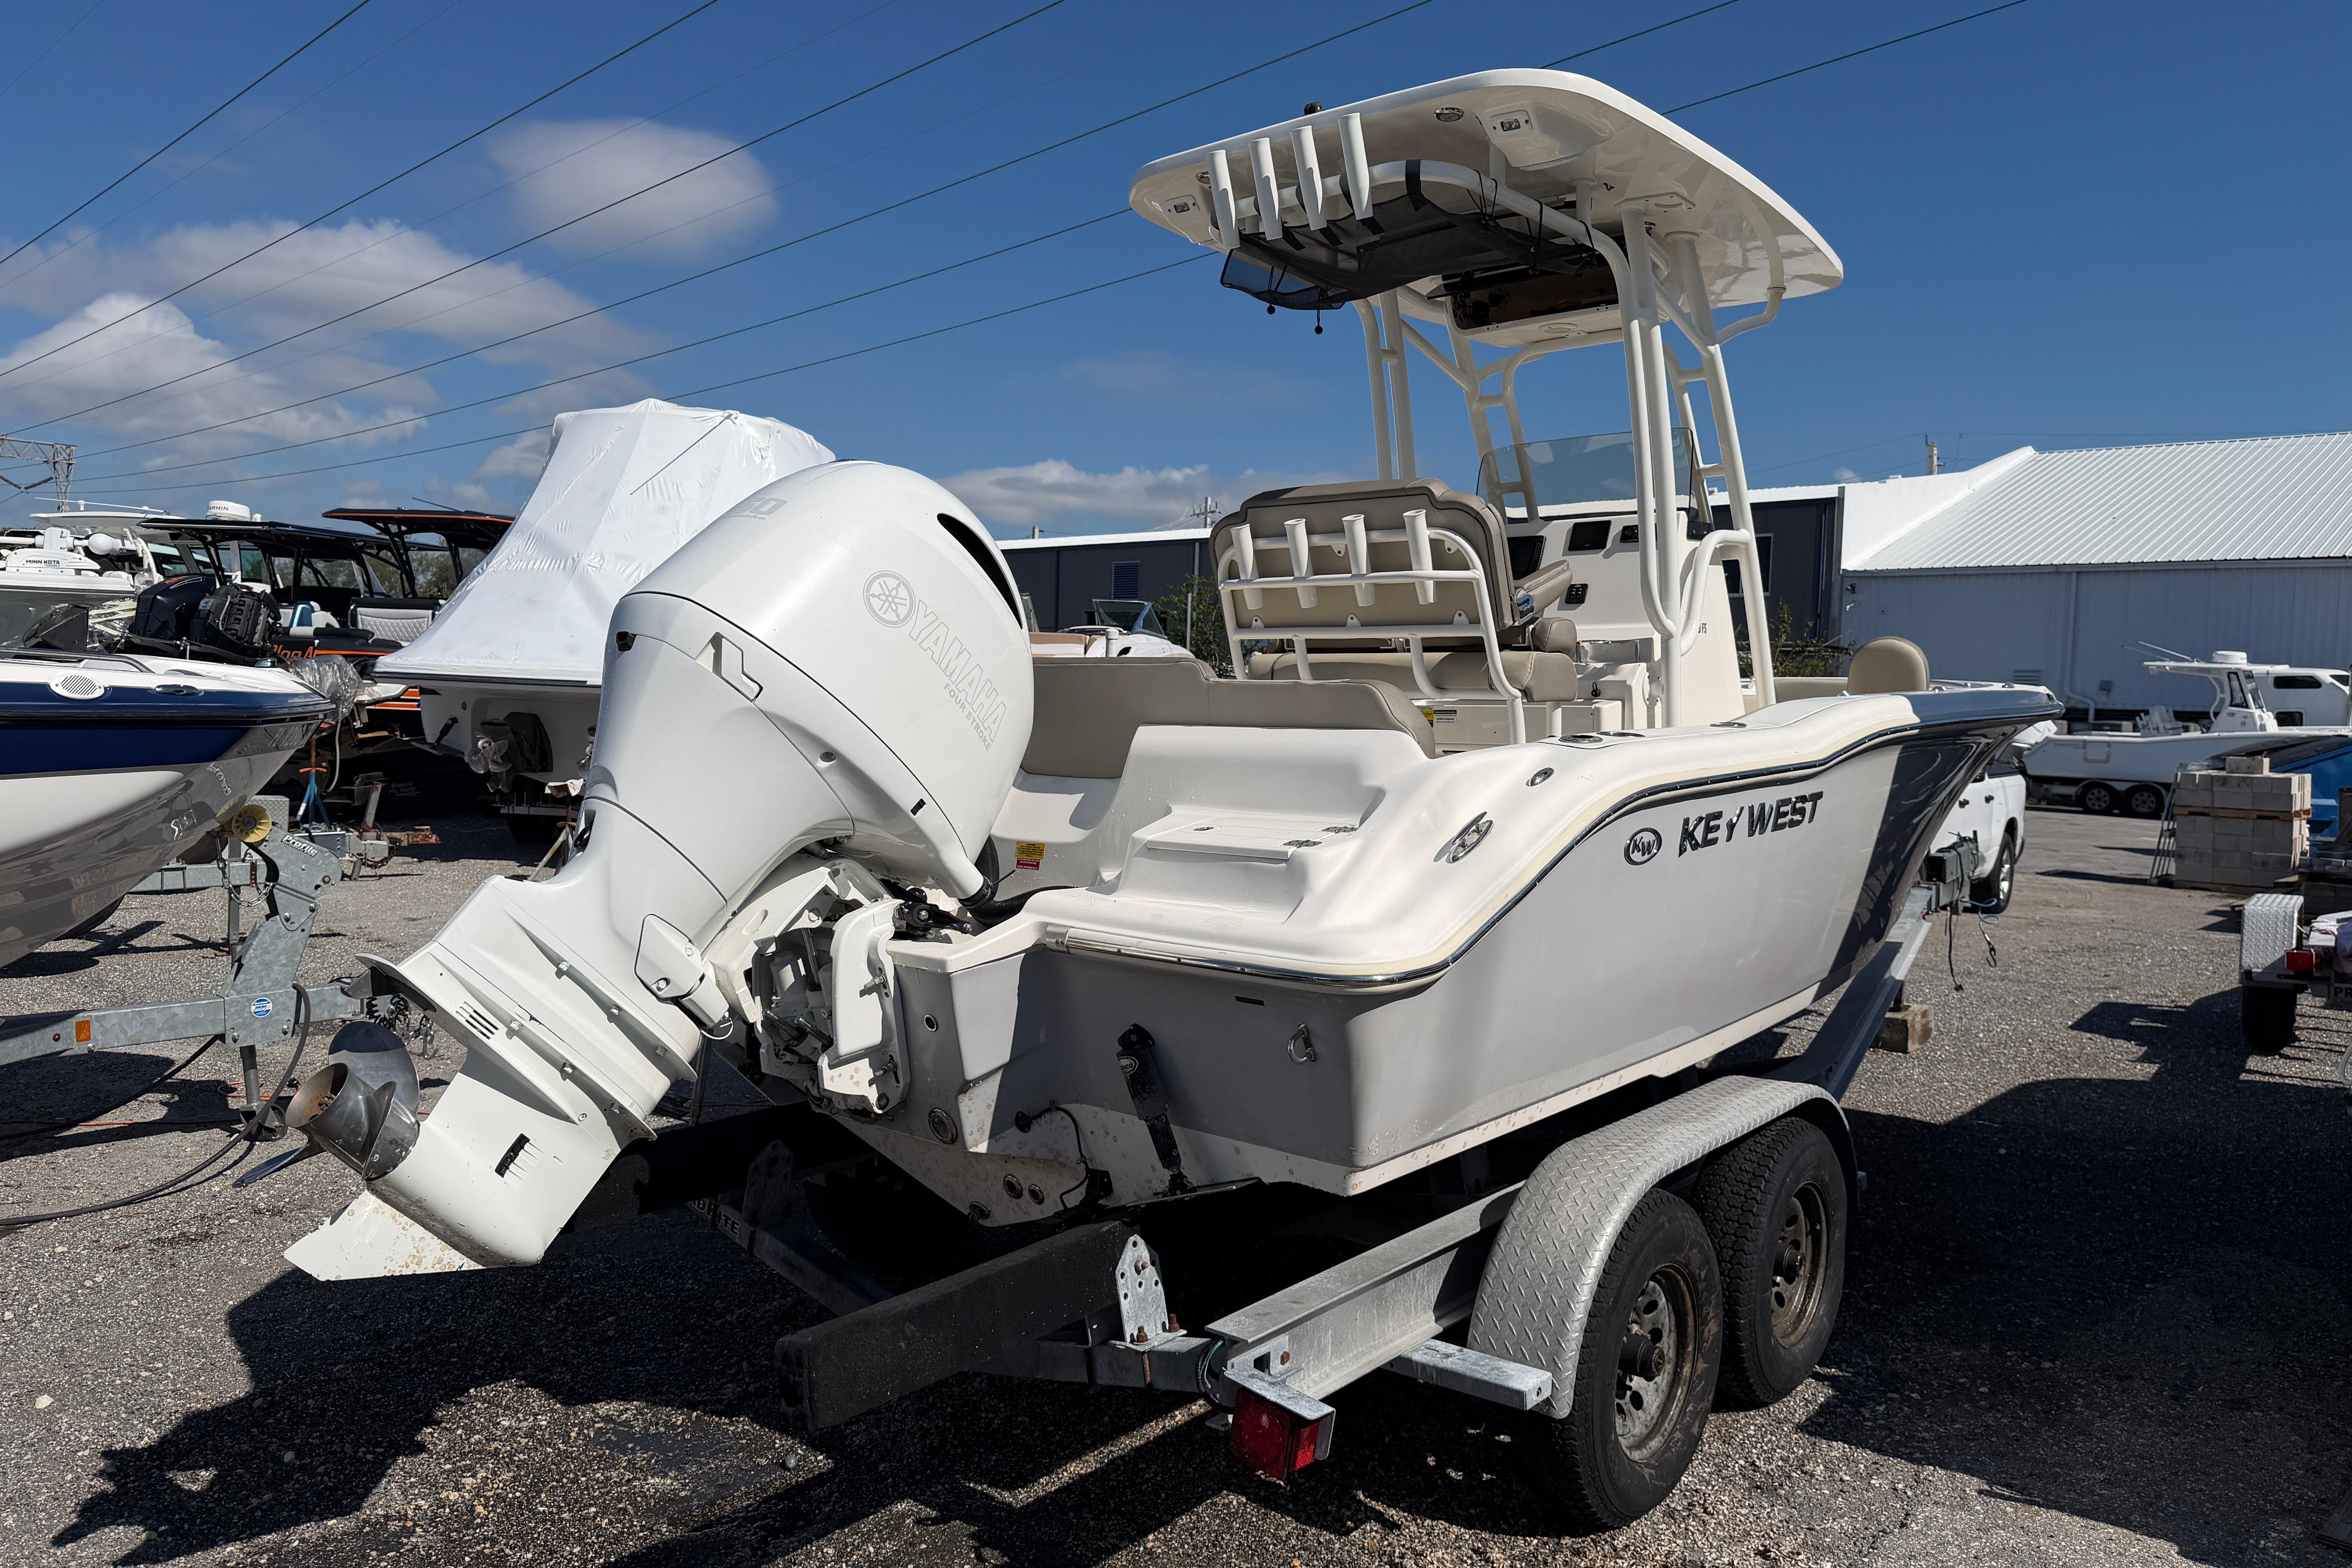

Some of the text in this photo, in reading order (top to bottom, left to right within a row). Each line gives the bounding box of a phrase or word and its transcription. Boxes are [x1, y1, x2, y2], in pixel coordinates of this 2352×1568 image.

[909, 599, 1006, 743] YAMAHA
[944, 682, 991, 751] FOUR STROKE
[281, 834, 319, 855] Profile
[1631, 836, 1656, 857] KW
[1678, 791, 1823, 858] KEY WEST
